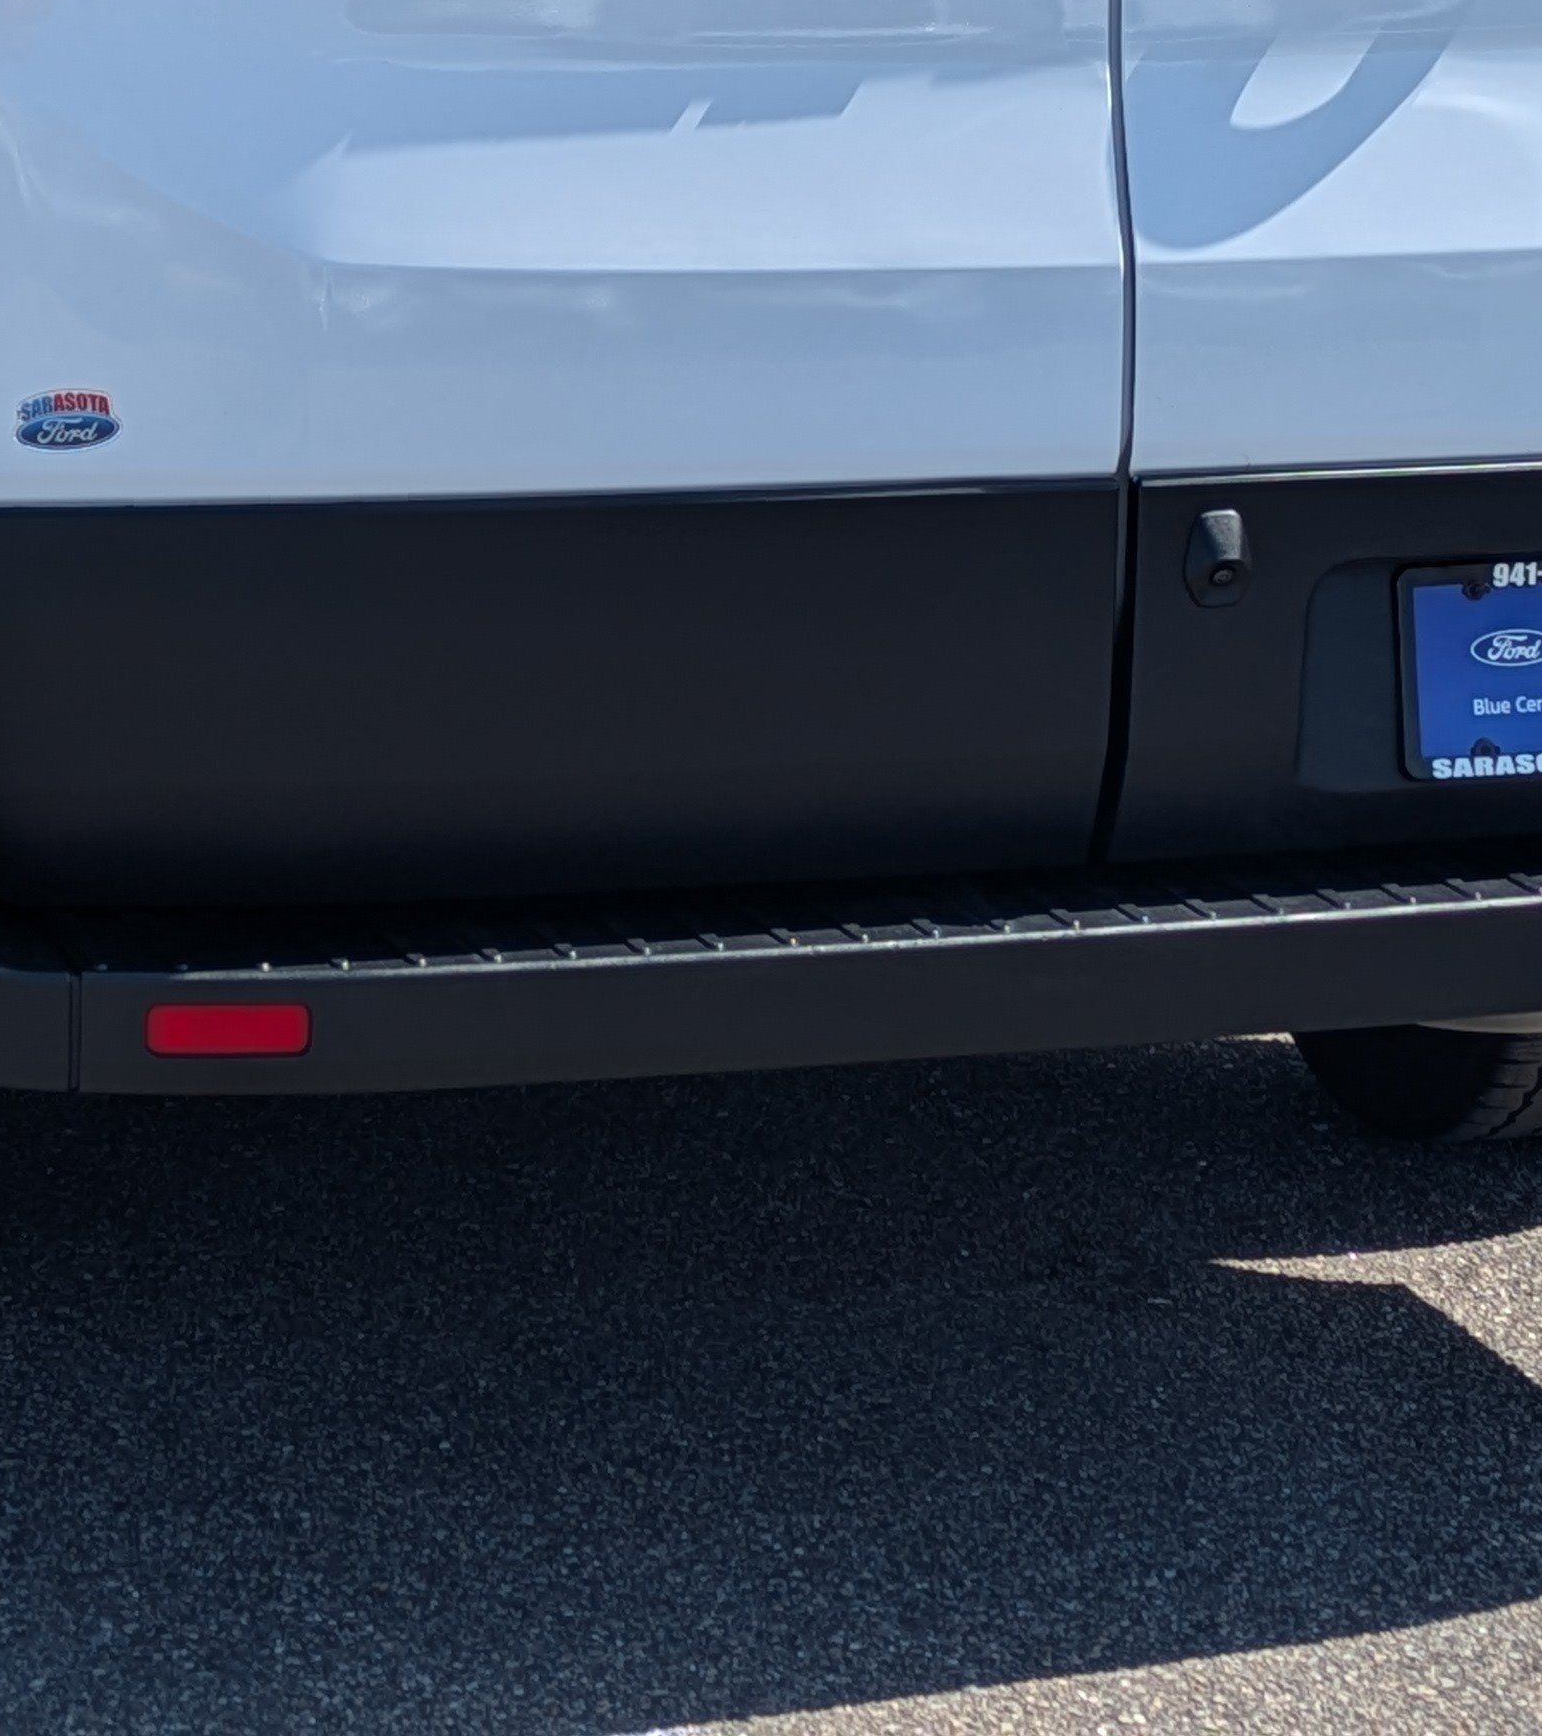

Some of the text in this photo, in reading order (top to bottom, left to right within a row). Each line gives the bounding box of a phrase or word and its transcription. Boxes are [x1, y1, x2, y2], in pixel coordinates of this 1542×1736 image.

[17, 392, 110, 422] SARASOTA
[36, 417, 100, 444] Ford
[1487, 634, 1542, 662] Ford
[1473, 698, 1510, 716] Blue
